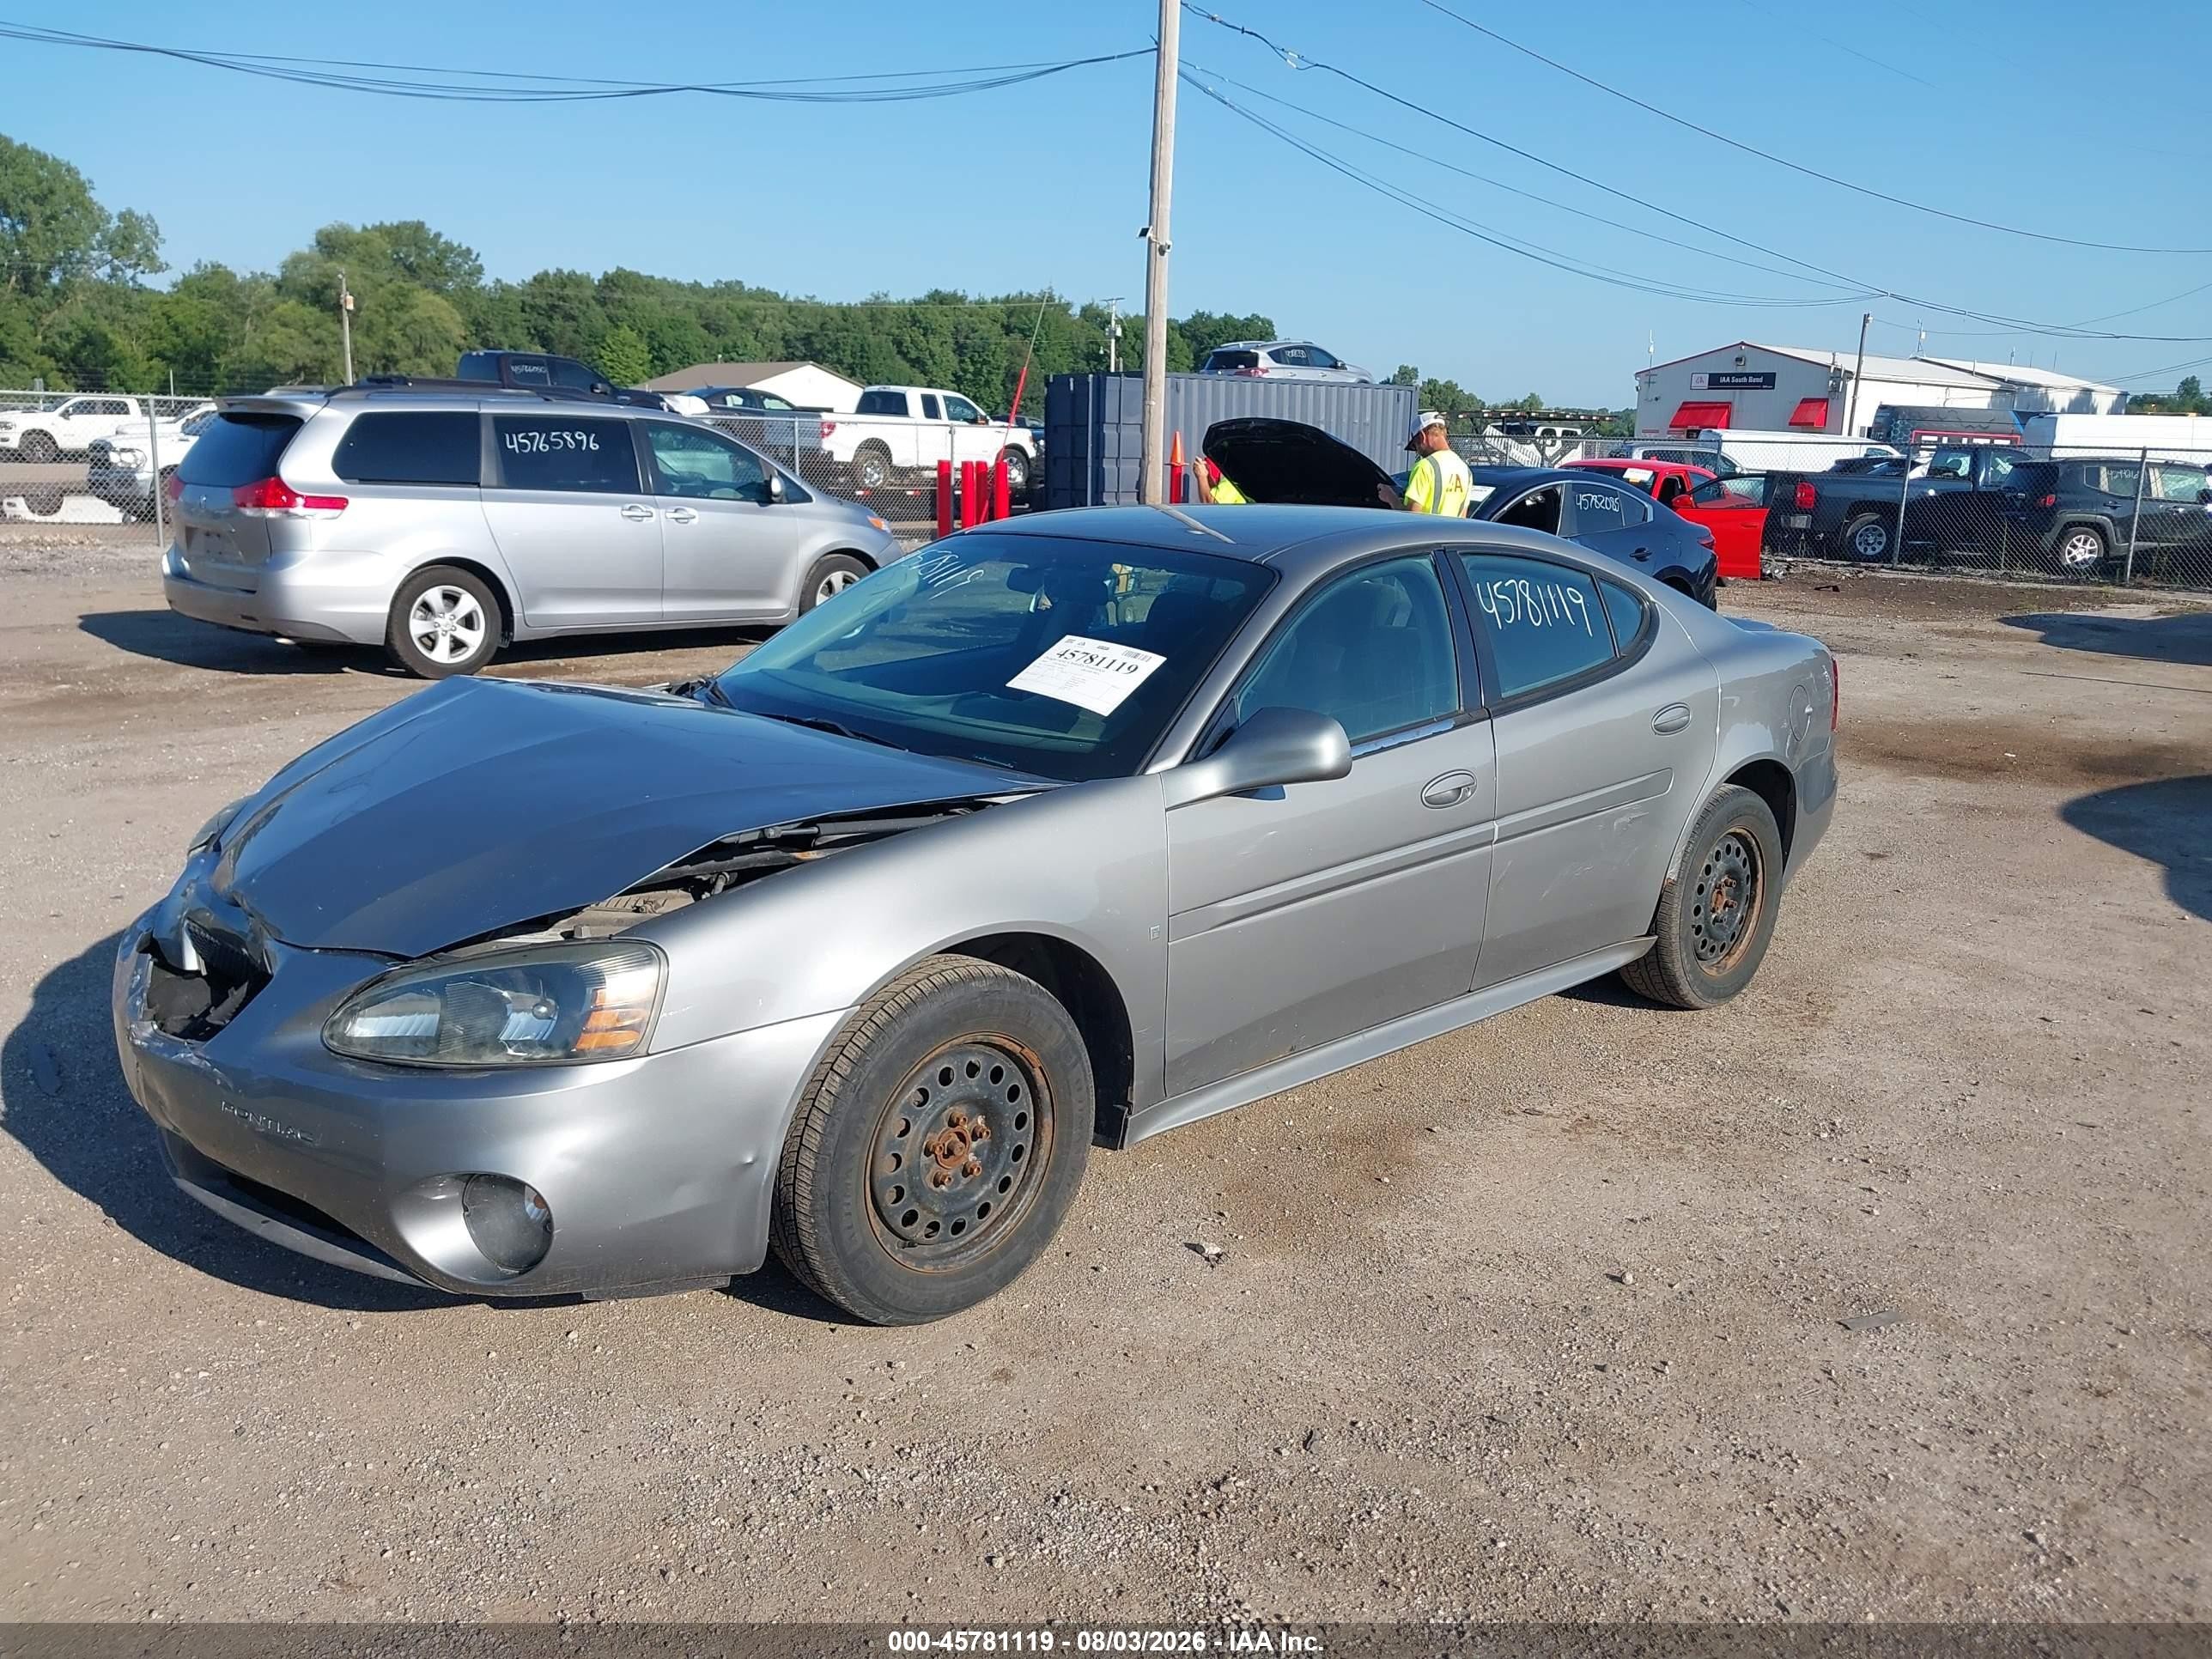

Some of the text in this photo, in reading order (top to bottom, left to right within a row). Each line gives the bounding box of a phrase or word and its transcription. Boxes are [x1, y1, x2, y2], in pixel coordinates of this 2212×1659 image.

[505, 431, 599, 453] 45765896
[1575, 493, 1620, 513] 45782085
[1476, 580, 1593, 637] 45781119
[1055, 648, 1139, 675] 45781119
